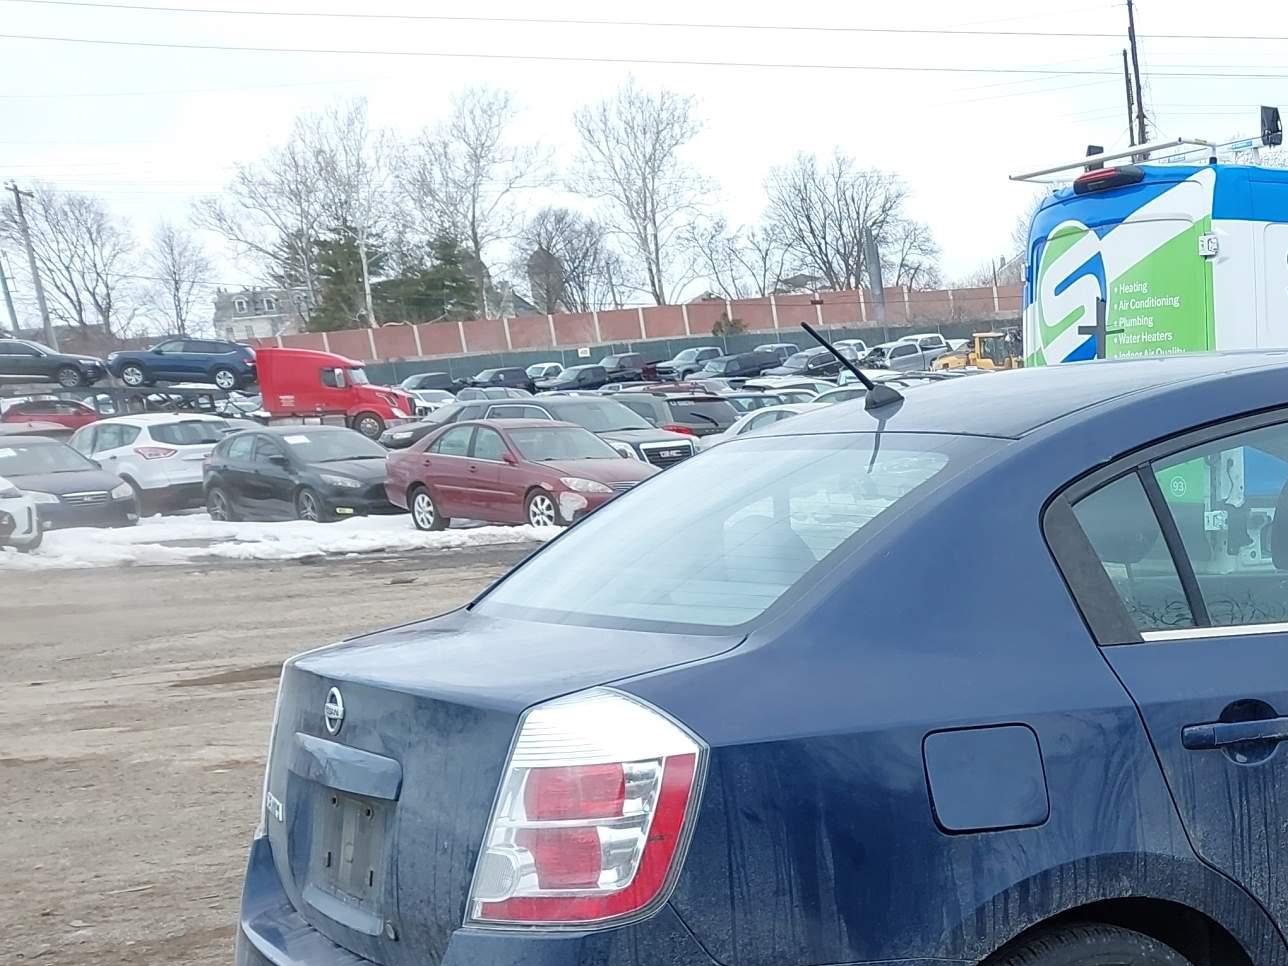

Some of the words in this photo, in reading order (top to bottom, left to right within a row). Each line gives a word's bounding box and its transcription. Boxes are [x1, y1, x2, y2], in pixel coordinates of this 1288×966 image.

[1119, 281, 1148, 294] Heating
[1119, 299, 1129, 311] Air
[1130, 295, 1180, 310] Conditioning
[1119, 314, 1154, 328] Plumbing
[1118, 332, 1140, 344] Water
[1142, 331, 1173, 342] Heaters
